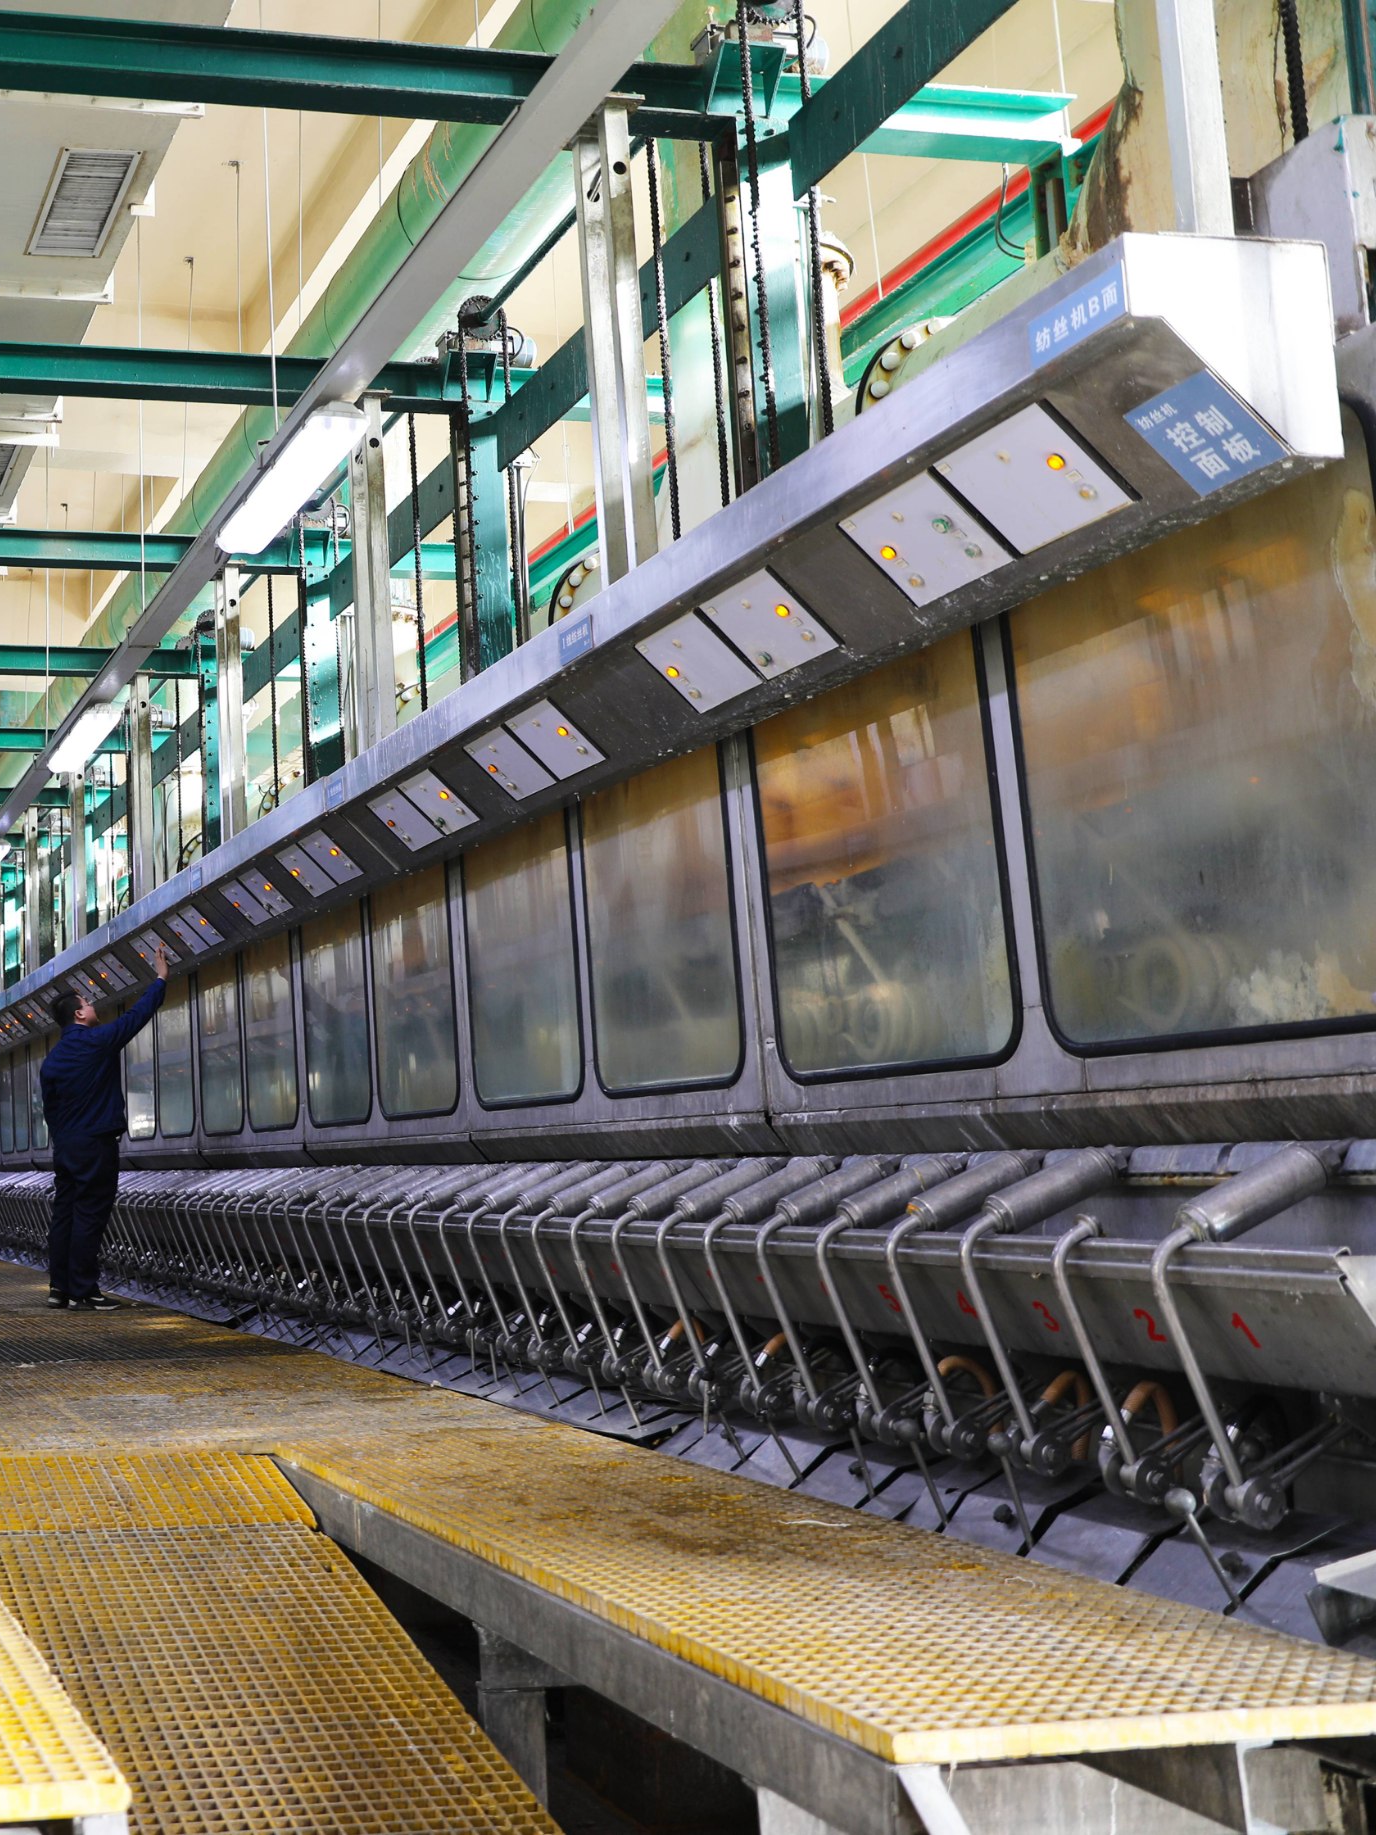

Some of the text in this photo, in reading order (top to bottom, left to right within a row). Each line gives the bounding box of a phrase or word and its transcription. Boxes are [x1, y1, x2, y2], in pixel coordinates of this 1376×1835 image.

[1035, 281, 1118, 353] 纺丝机B面
[1135, 402, 1178, 430] 纺丝机
[1165, 404, 1234, 453] 控制
[1189, 432, 1261, 480] 面板
[1031, 1300, 1060, 1333] 3
[1133, 1307, 1168, 1343] 2
[1231, 1311, 1262, 1349] 1
